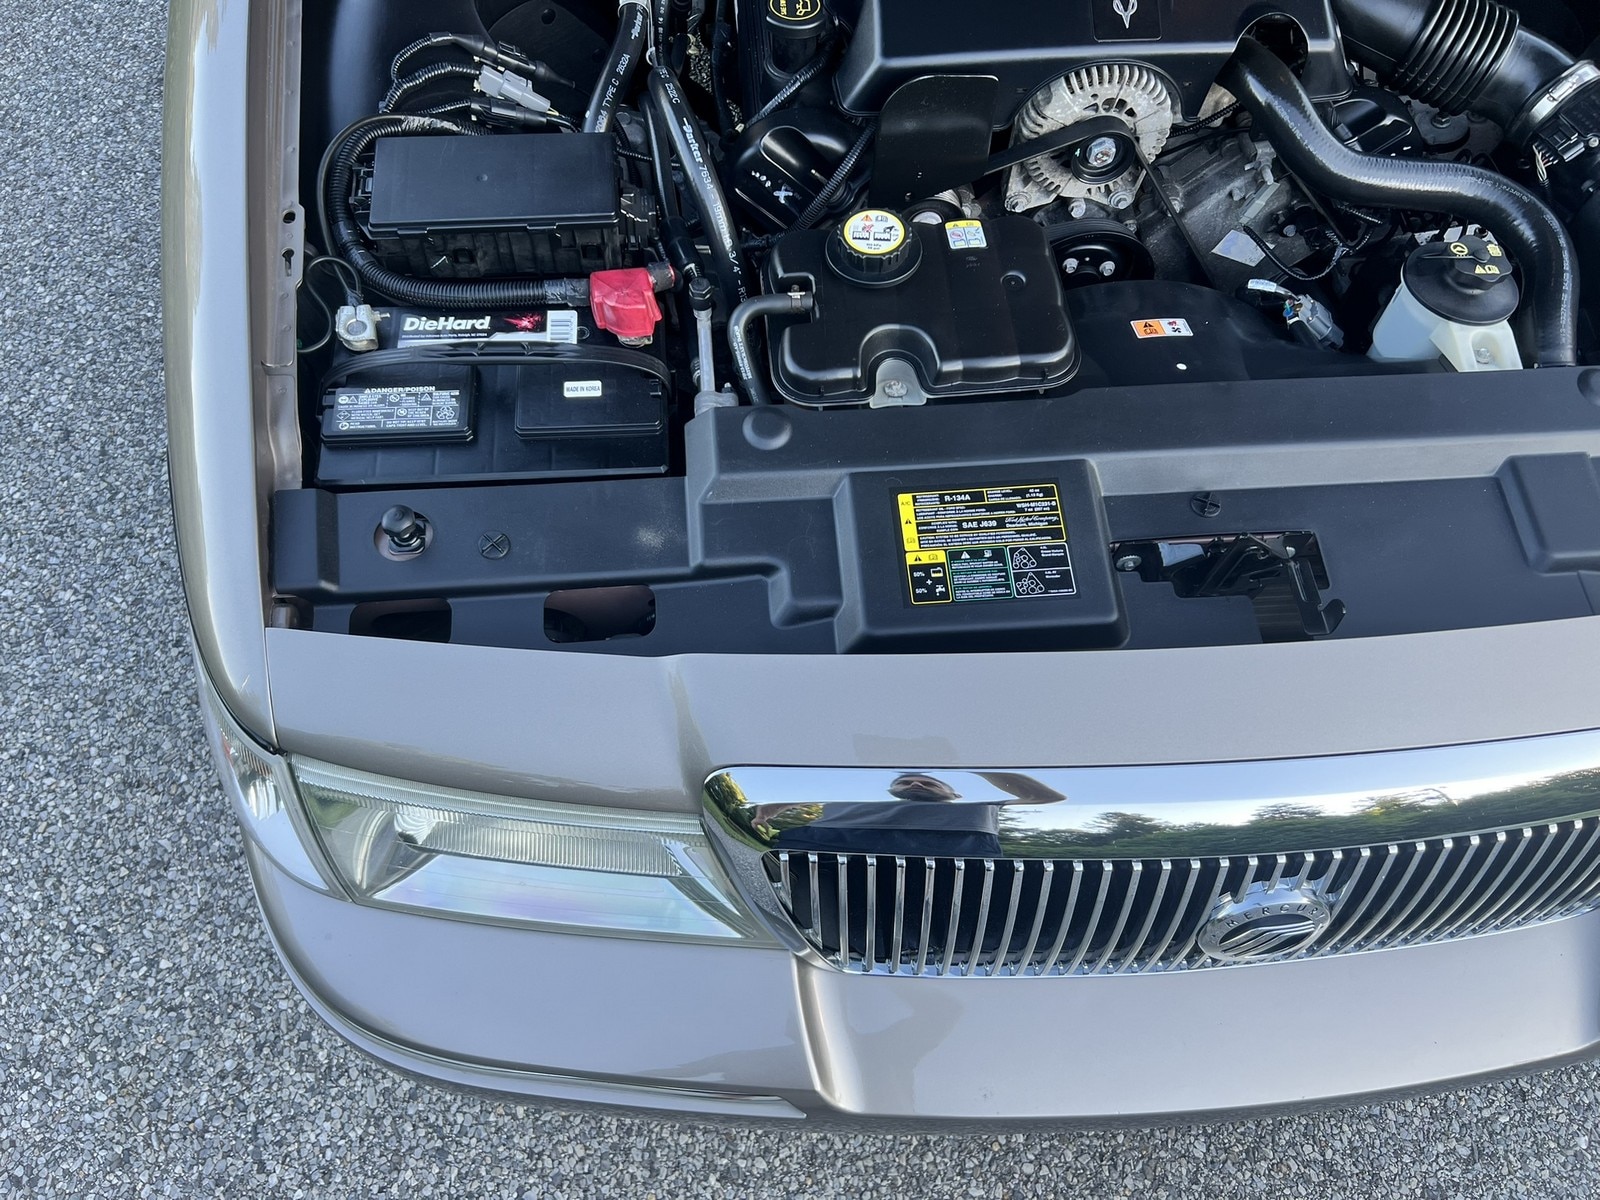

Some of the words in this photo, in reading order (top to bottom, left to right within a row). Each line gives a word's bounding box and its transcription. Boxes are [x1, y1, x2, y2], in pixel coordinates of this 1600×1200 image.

[602, 85, 617, 108] TYPE
[611, 78, 620, 86] C
[683, 117, 703, 164] Parker
[699, 165, 714, 190] 7634
[403, 316, 491, 331] DieHard
[944, 494, 971, 502] R-134A
[979, 520, 998, 528] J639
[1225, 904, 1326, 928] MERCURY
